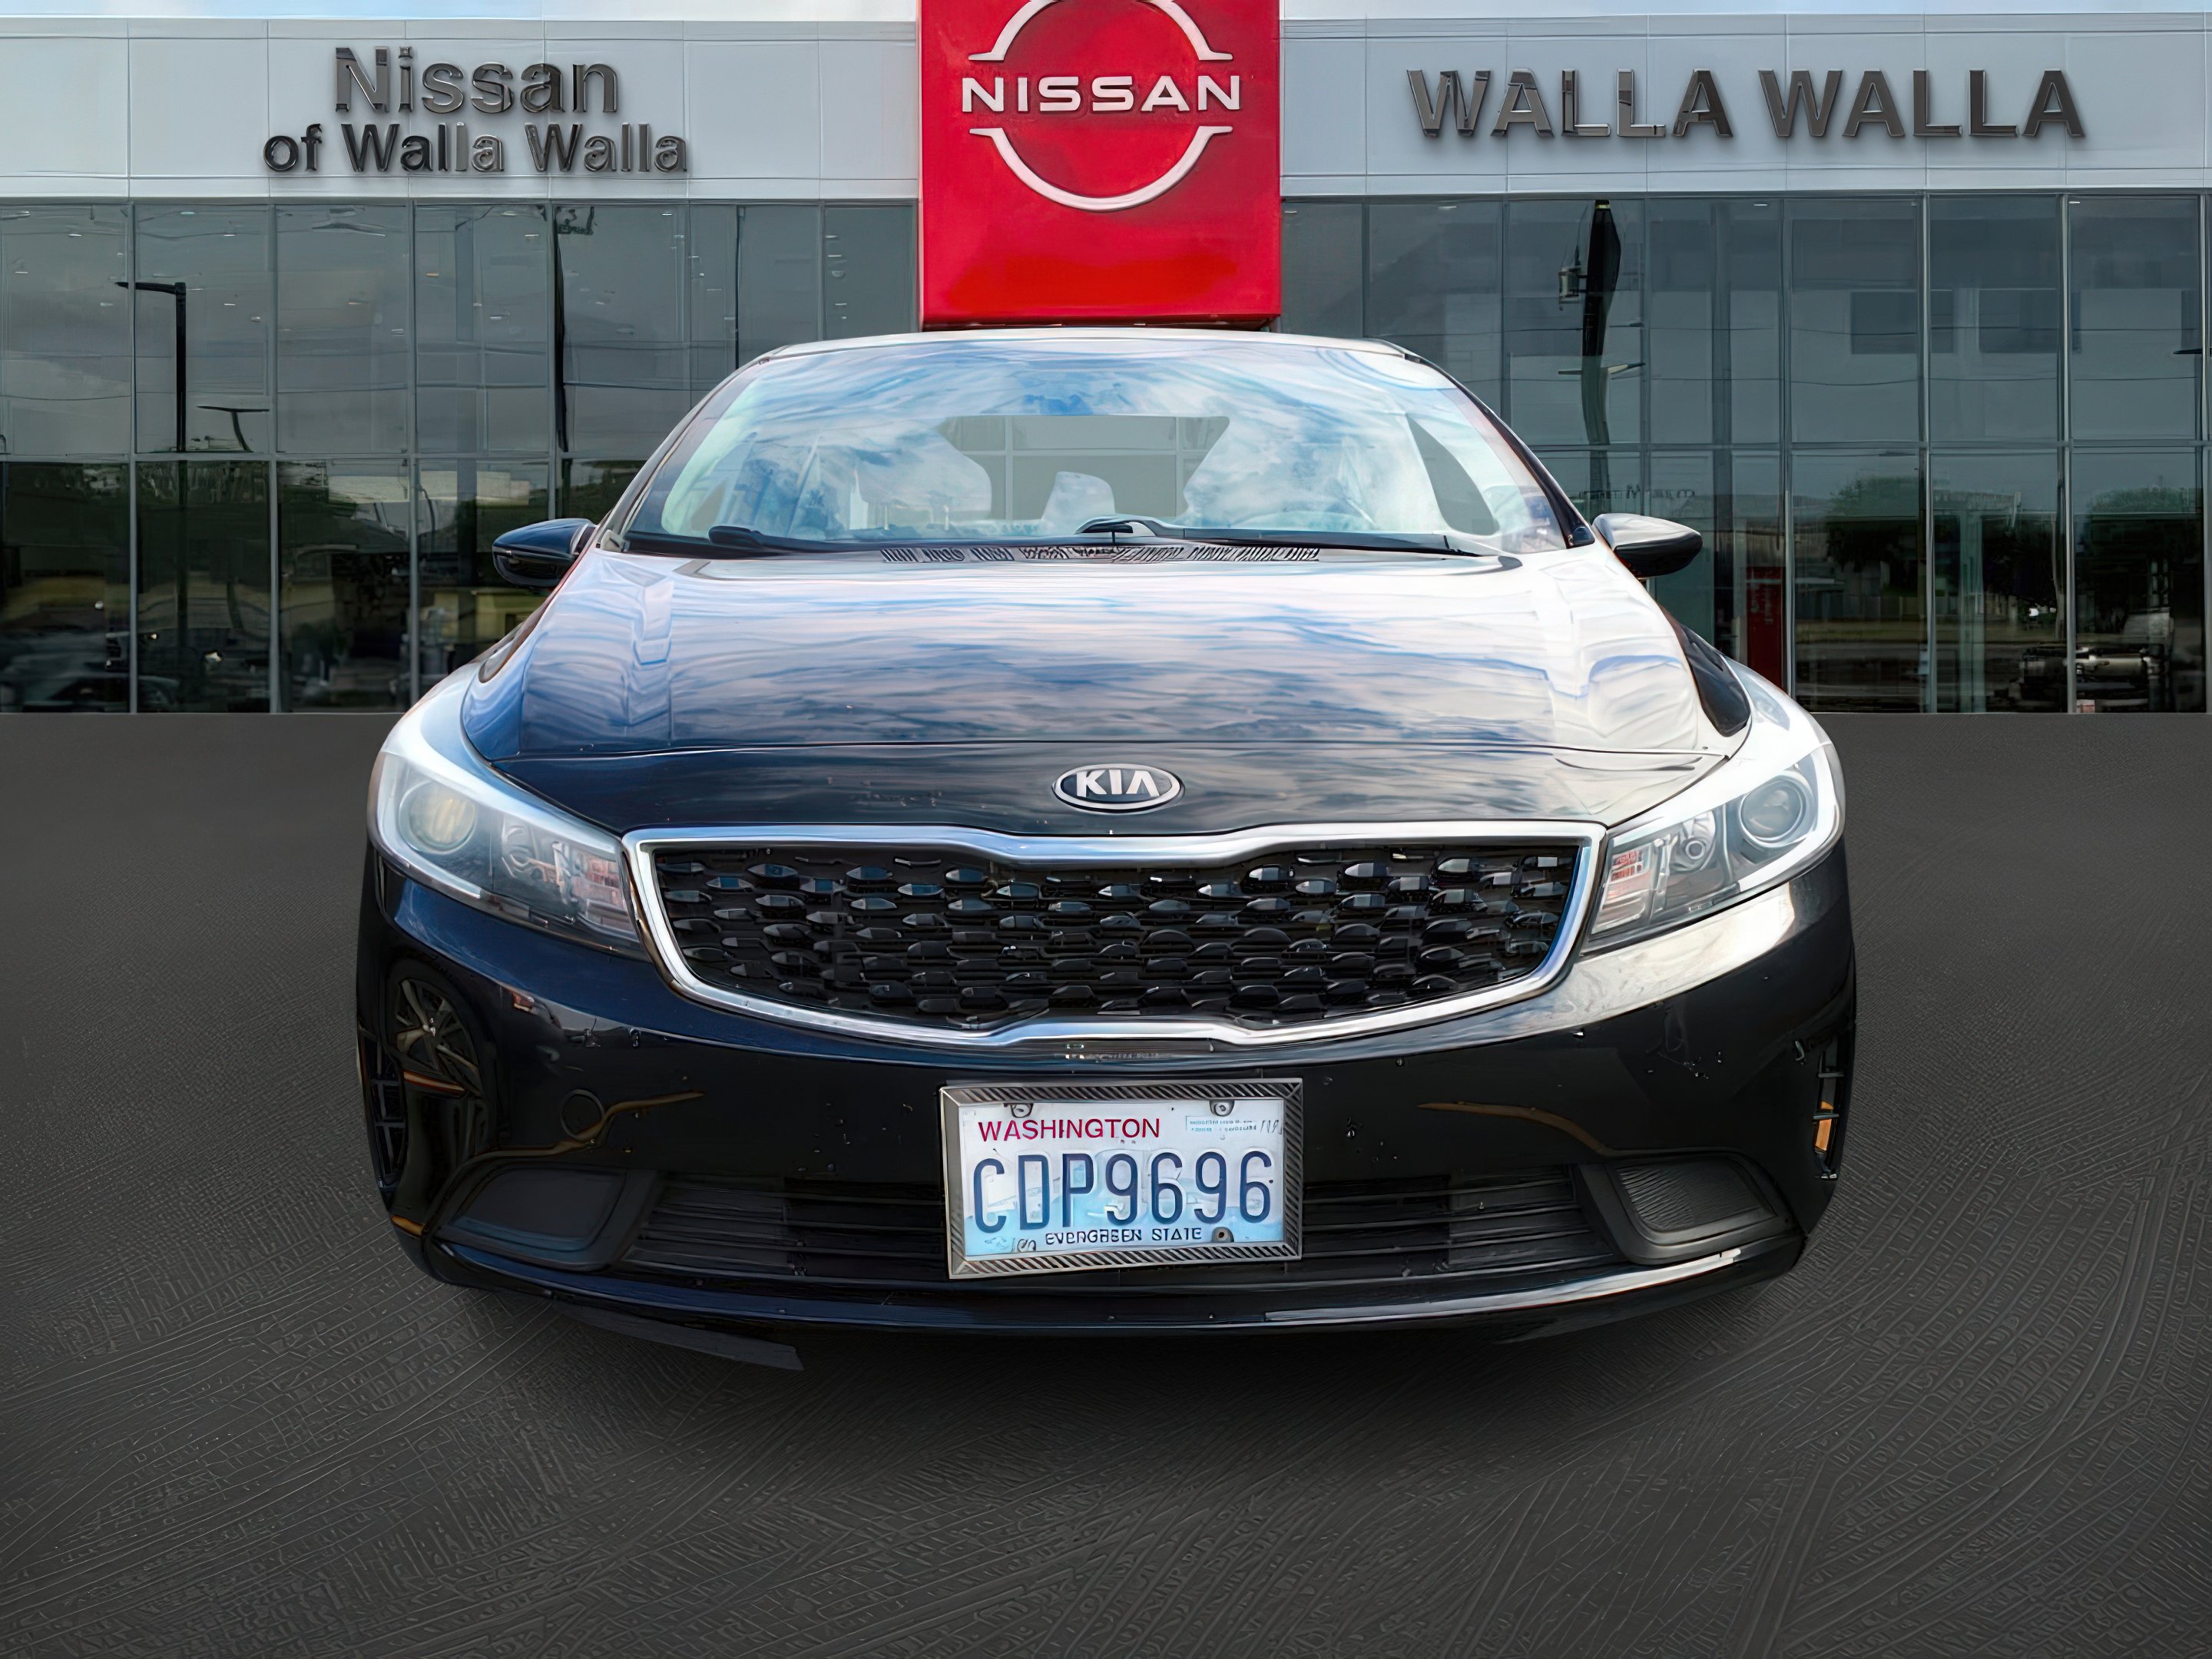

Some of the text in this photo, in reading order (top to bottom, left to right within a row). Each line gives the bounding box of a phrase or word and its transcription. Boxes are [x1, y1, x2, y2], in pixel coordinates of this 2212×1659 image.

[335, 46, 618, 114] Nissan
[962, 75, 1240, 112] NISSAN
[1406, 68, 2085, 138] WALLA WALLA
[263, 122, 687, 172] of Walla Walla
[1076, 769, 1161, 797] KIA
[979, 1118, 1161, 1142] WASHINGTON
[973, 1151, 1273, 1233] CDP9696
[1151, 1227, 1202, 1241] STATE
